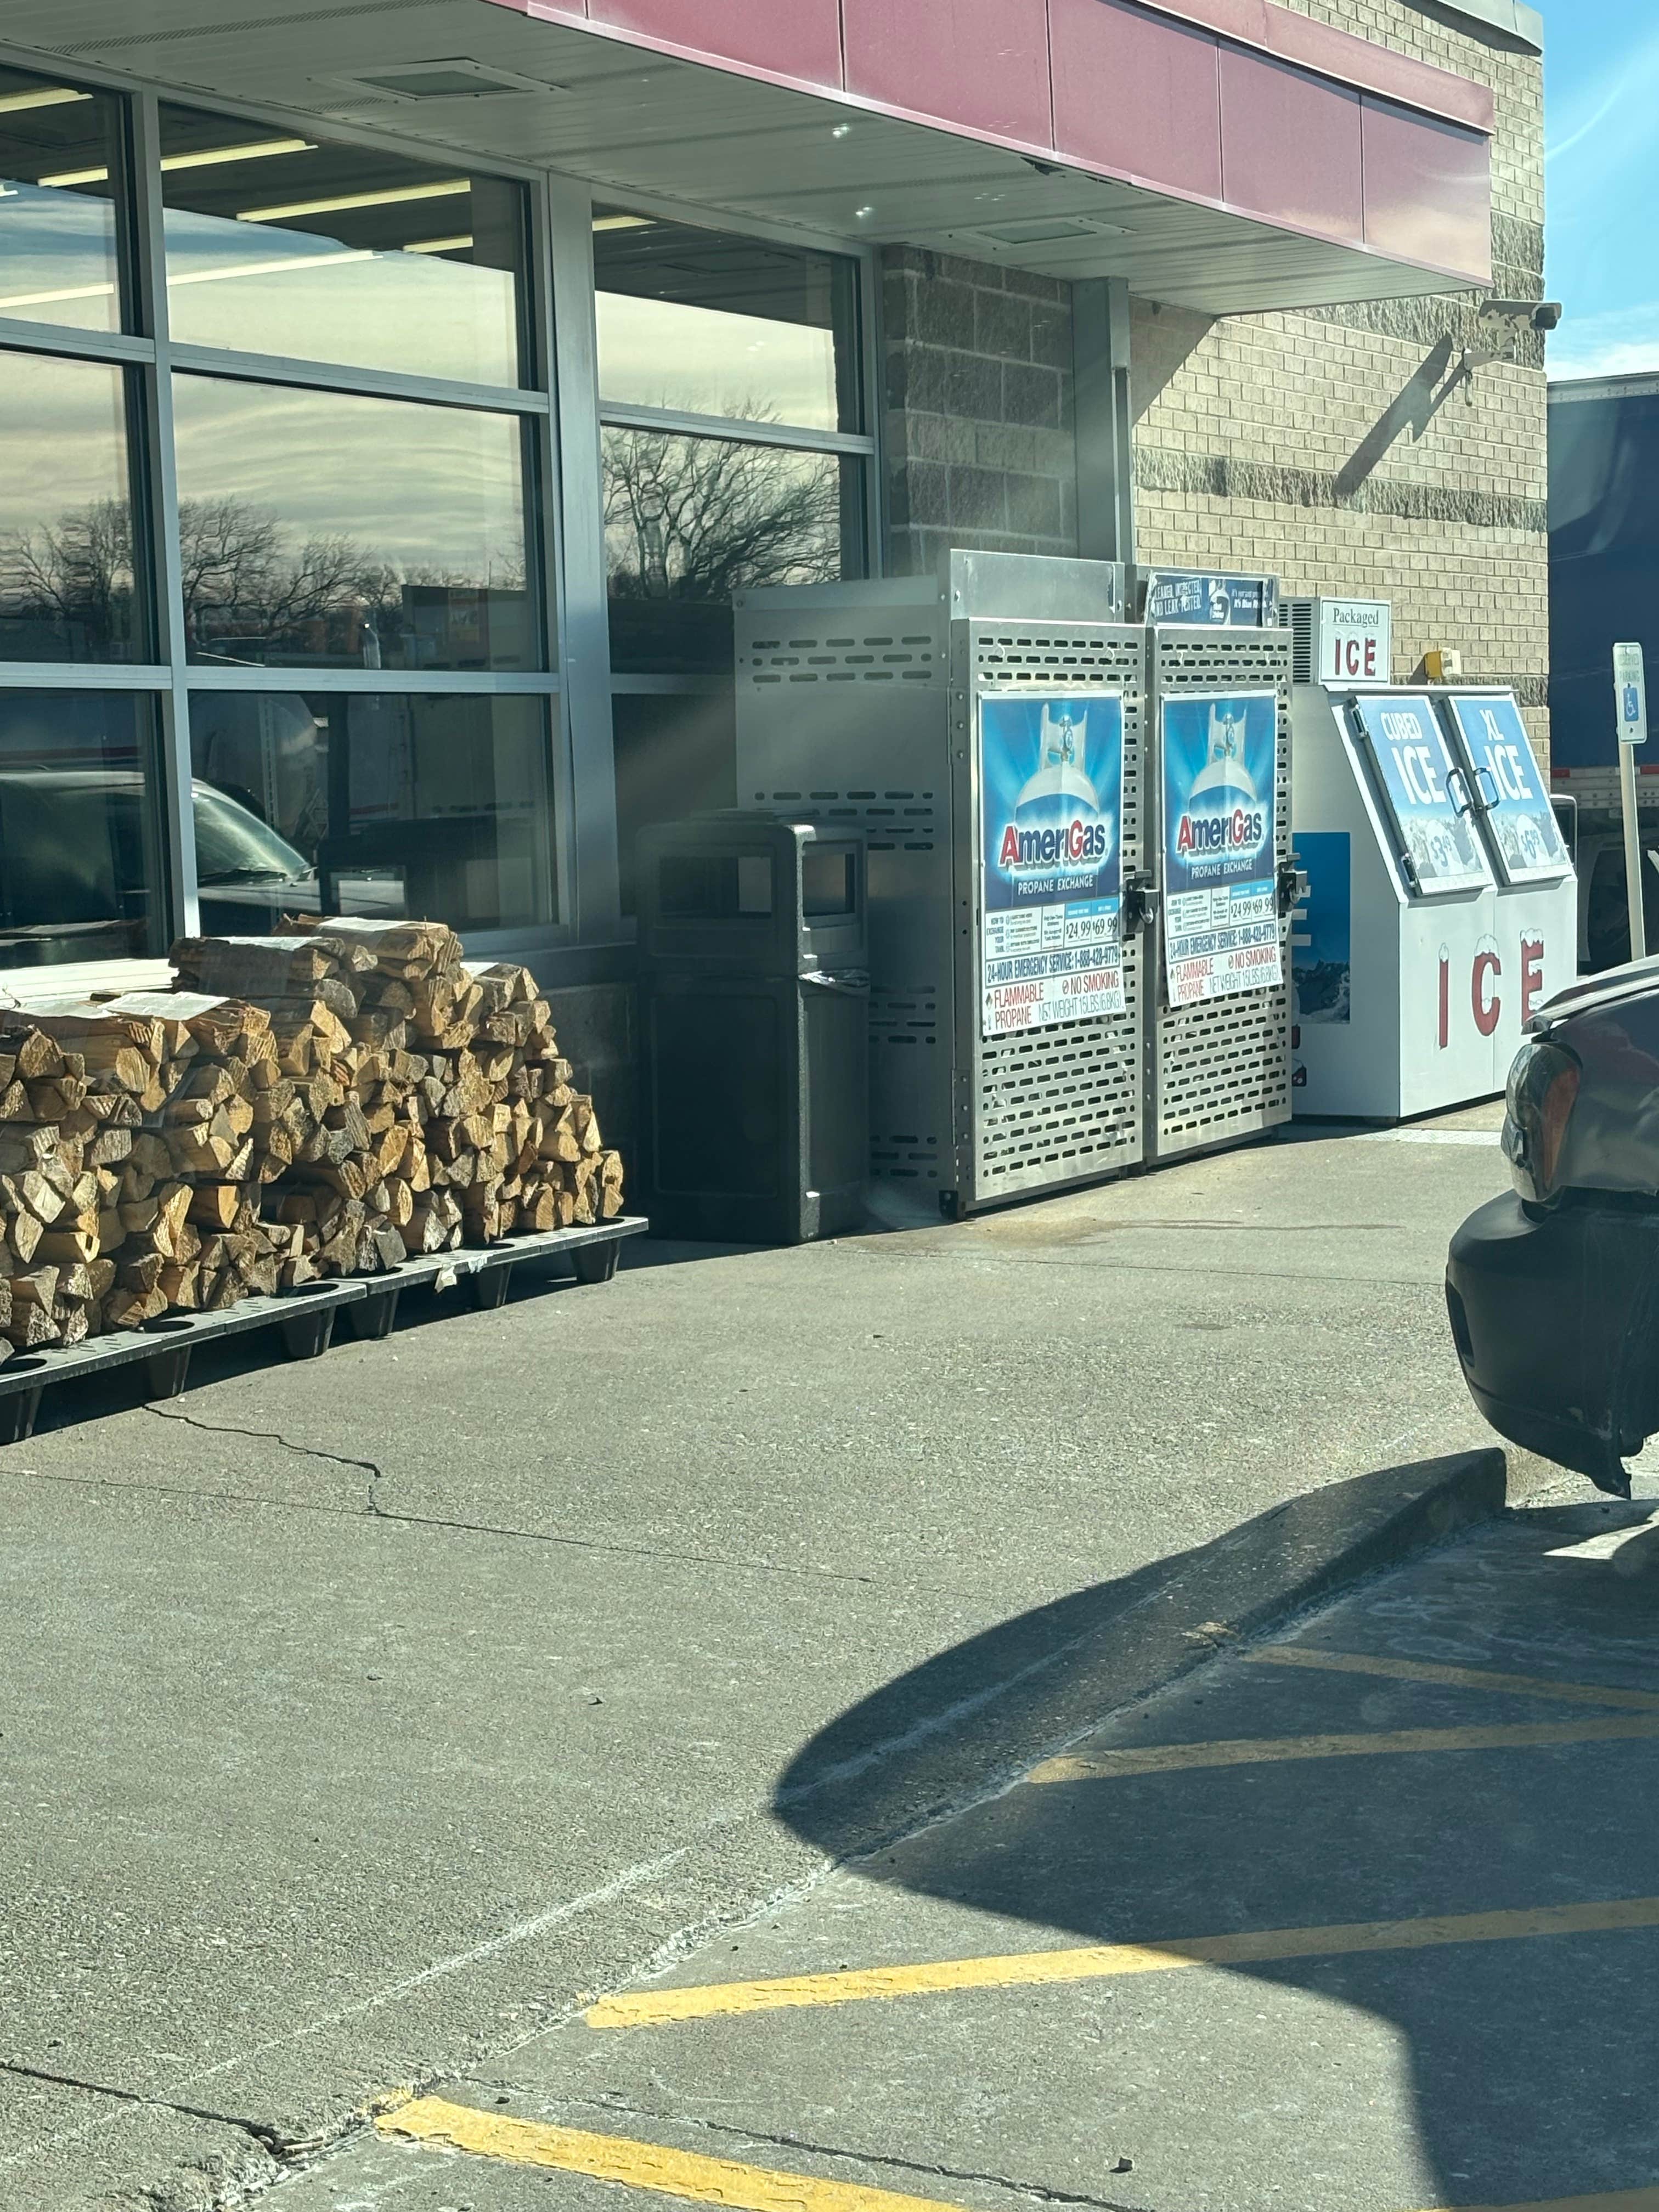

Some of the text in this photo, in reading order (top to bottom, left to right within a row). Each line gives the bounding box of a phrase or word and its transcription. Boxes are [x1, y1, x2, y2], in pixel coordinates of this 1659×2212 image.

[1333, 608, 1379, 628] Packaged
[1335, 634, 1376, 676] ICE
[1380, 712, 1422, 741] CUBED
[1480, 710, 1504, 741] XL
[1392, 746, 1447, 804] ICE
[1484, 745, 1533, 800] ICE
[999, 819, 1107, 866] AmeriGas
[1176, 809, 1263, 852] AmeriGas
[1191, 859, 1252, 879] PROPANE EXCHANGE
[1018, 875, 1093, 895] PROPANE EXCHANGE
[1066, 921, 1091, 939] $24.99
[1092, 917, 1118, 935] $69.99
[987, 960, 1013, 983] 24-HOUR
[1014, 955, 1048, 978] EMERGENCY
[1176, 946, 1276, 983] FLAMMABLE NO SMOKING
[994, 970, 1119, 1008] FLAMMABLE NO SMOKING
[1177, 979, 1204, 1002] PROPANE
[1438, 928, 1544, 1050] ICE
[995, 1006, 1031, 1029] PROPANE
[1053, 997, 1077, 1019] WEIGHT
